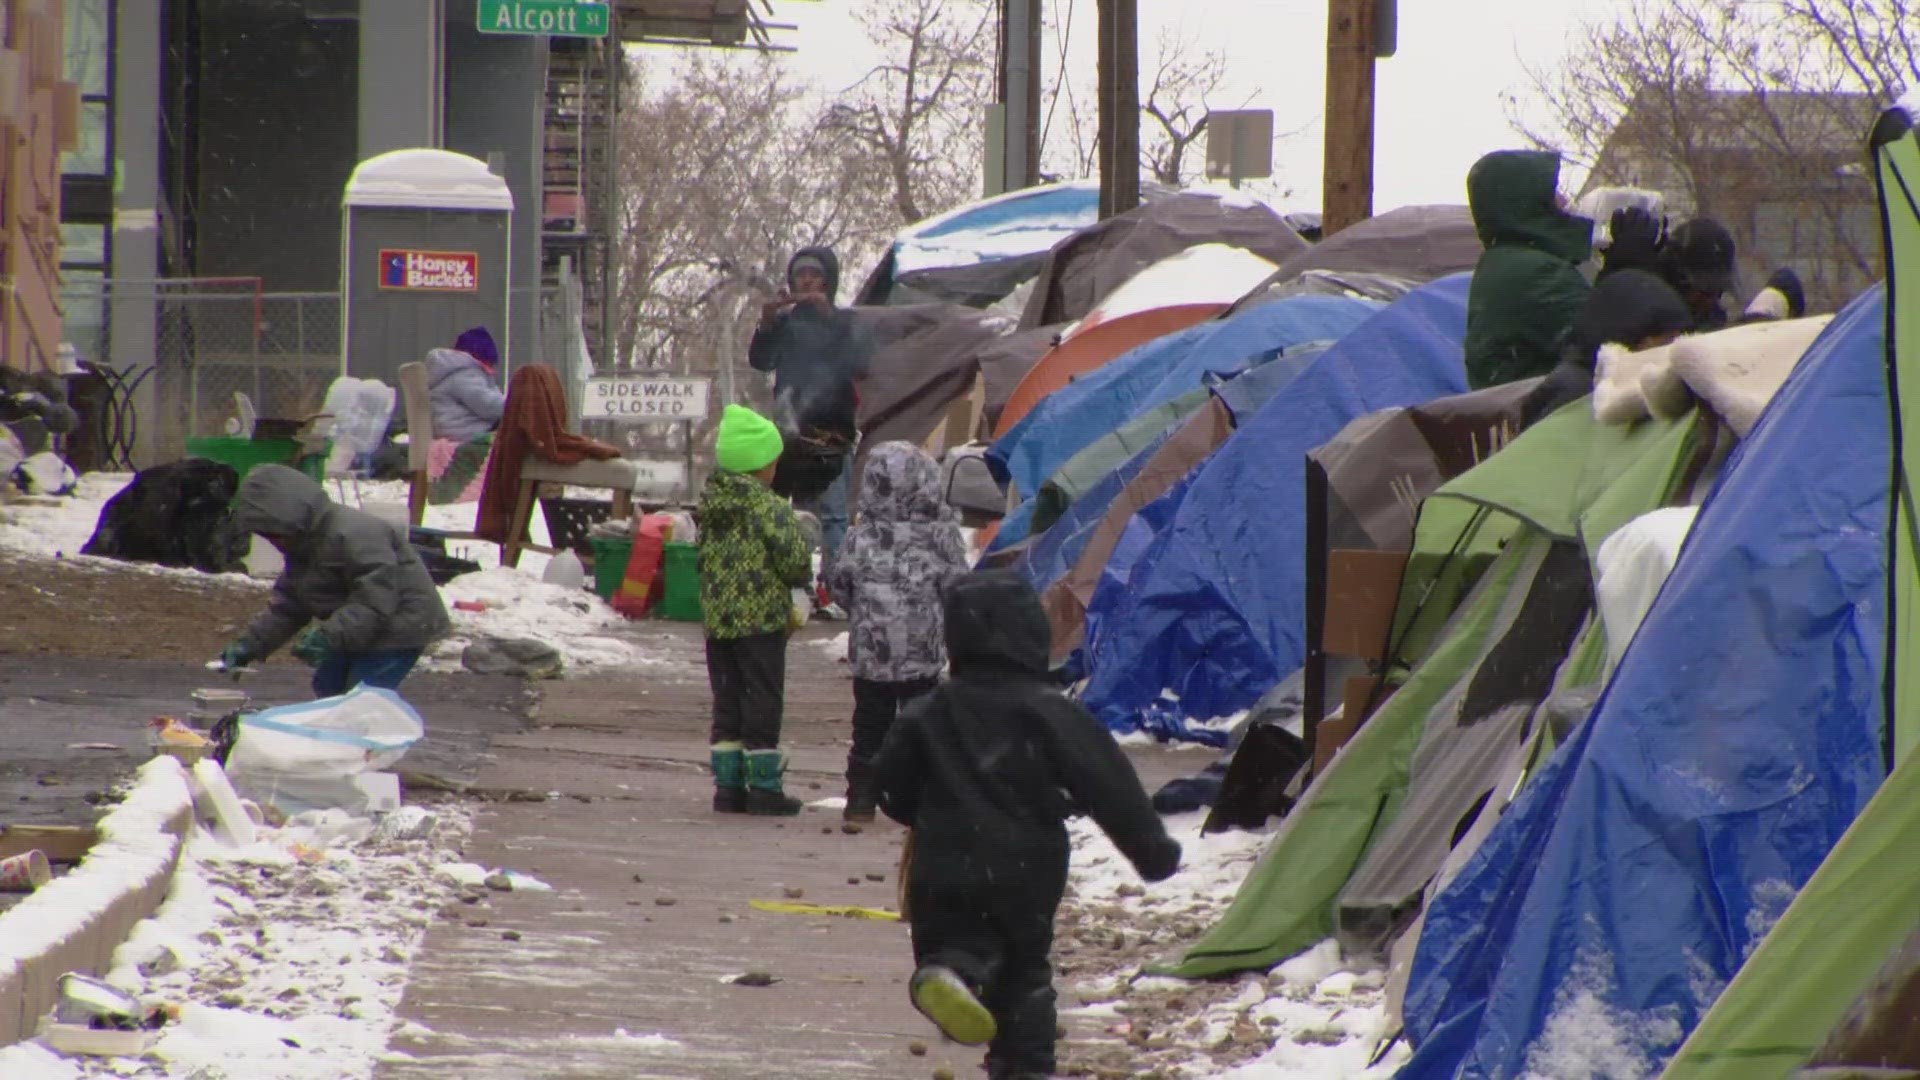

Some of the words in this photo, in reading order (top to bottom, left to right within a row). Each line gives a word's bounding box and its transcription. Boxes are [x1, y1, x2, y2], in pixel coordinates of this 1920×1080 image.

[496, 4, 577, 32] Alcott
[406, 253, 469, 275] Honey
[407, 271, 474, 288] Bucket
[598, 383, 694, 397] SIDEWALK
[605, 400, 684, 414] CLOSED
